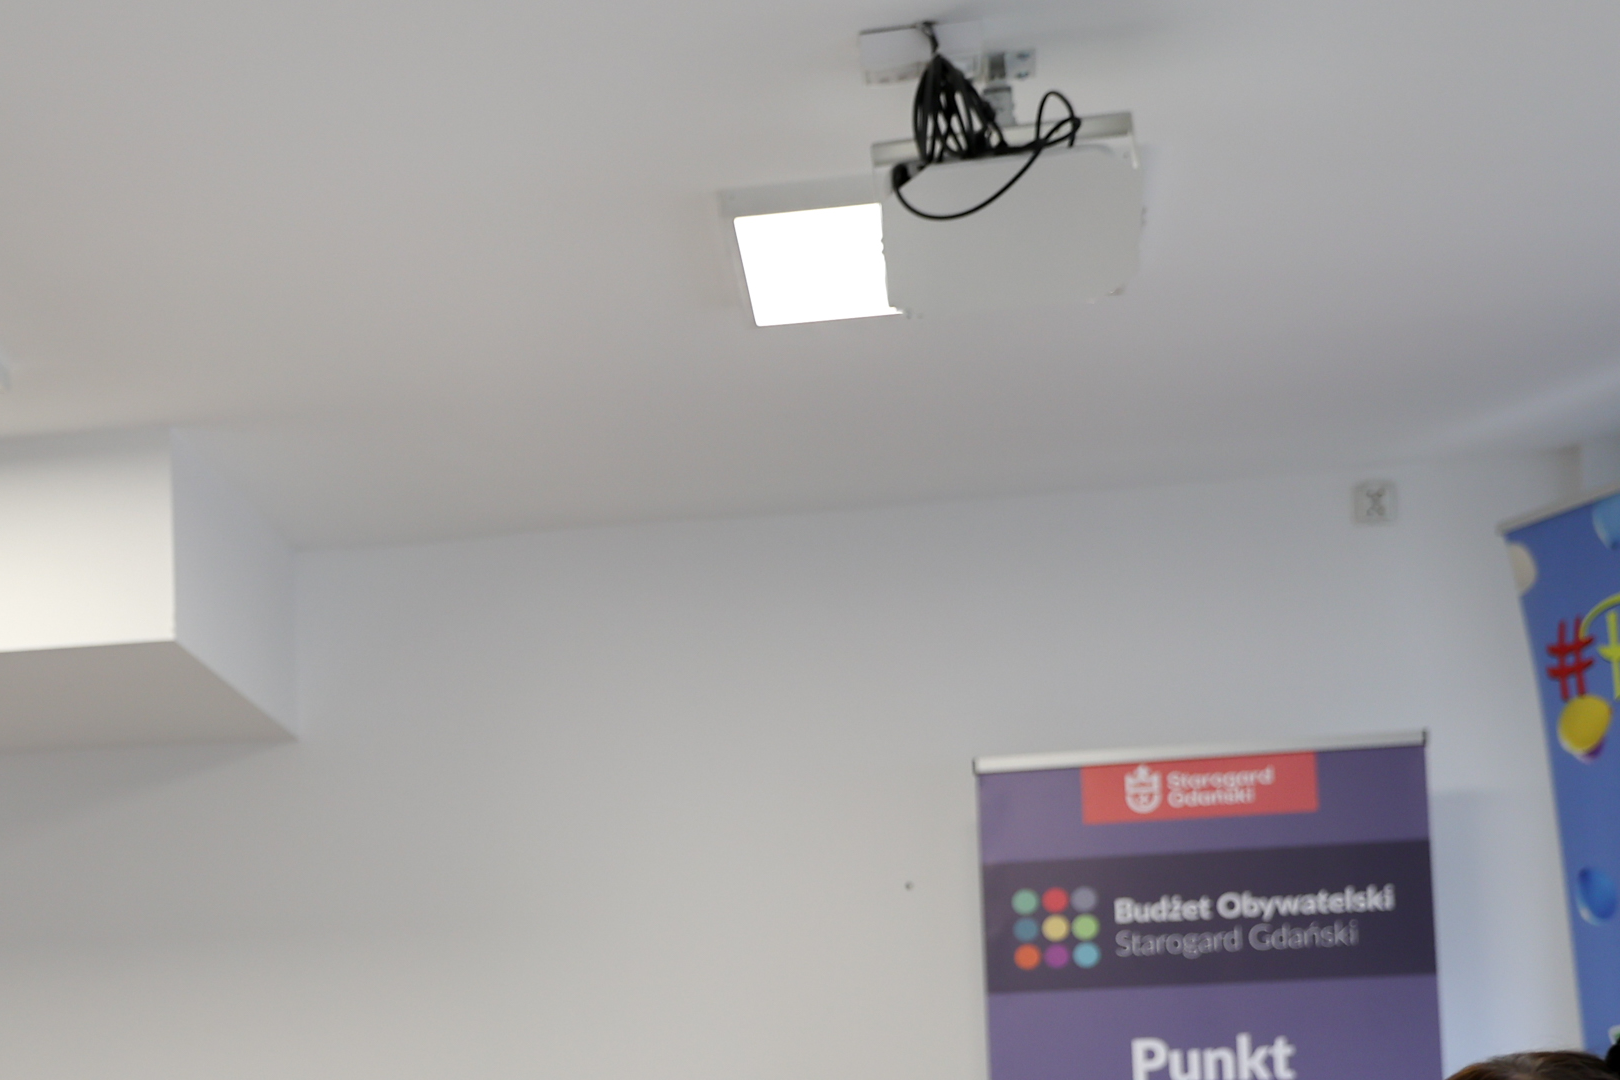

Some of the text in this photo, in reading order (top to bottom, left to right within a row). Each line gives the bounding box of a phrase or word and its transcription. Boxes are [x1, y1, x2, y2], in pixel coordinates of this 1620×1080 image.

[1166, 765, 1275, 791] Starogard
[1167, 786, 1255, 808] Gdański
[1114, 883, 1396, 925] Budżet Obywatelski
[1115, 919, 1359, 960] Starogard Gdański
